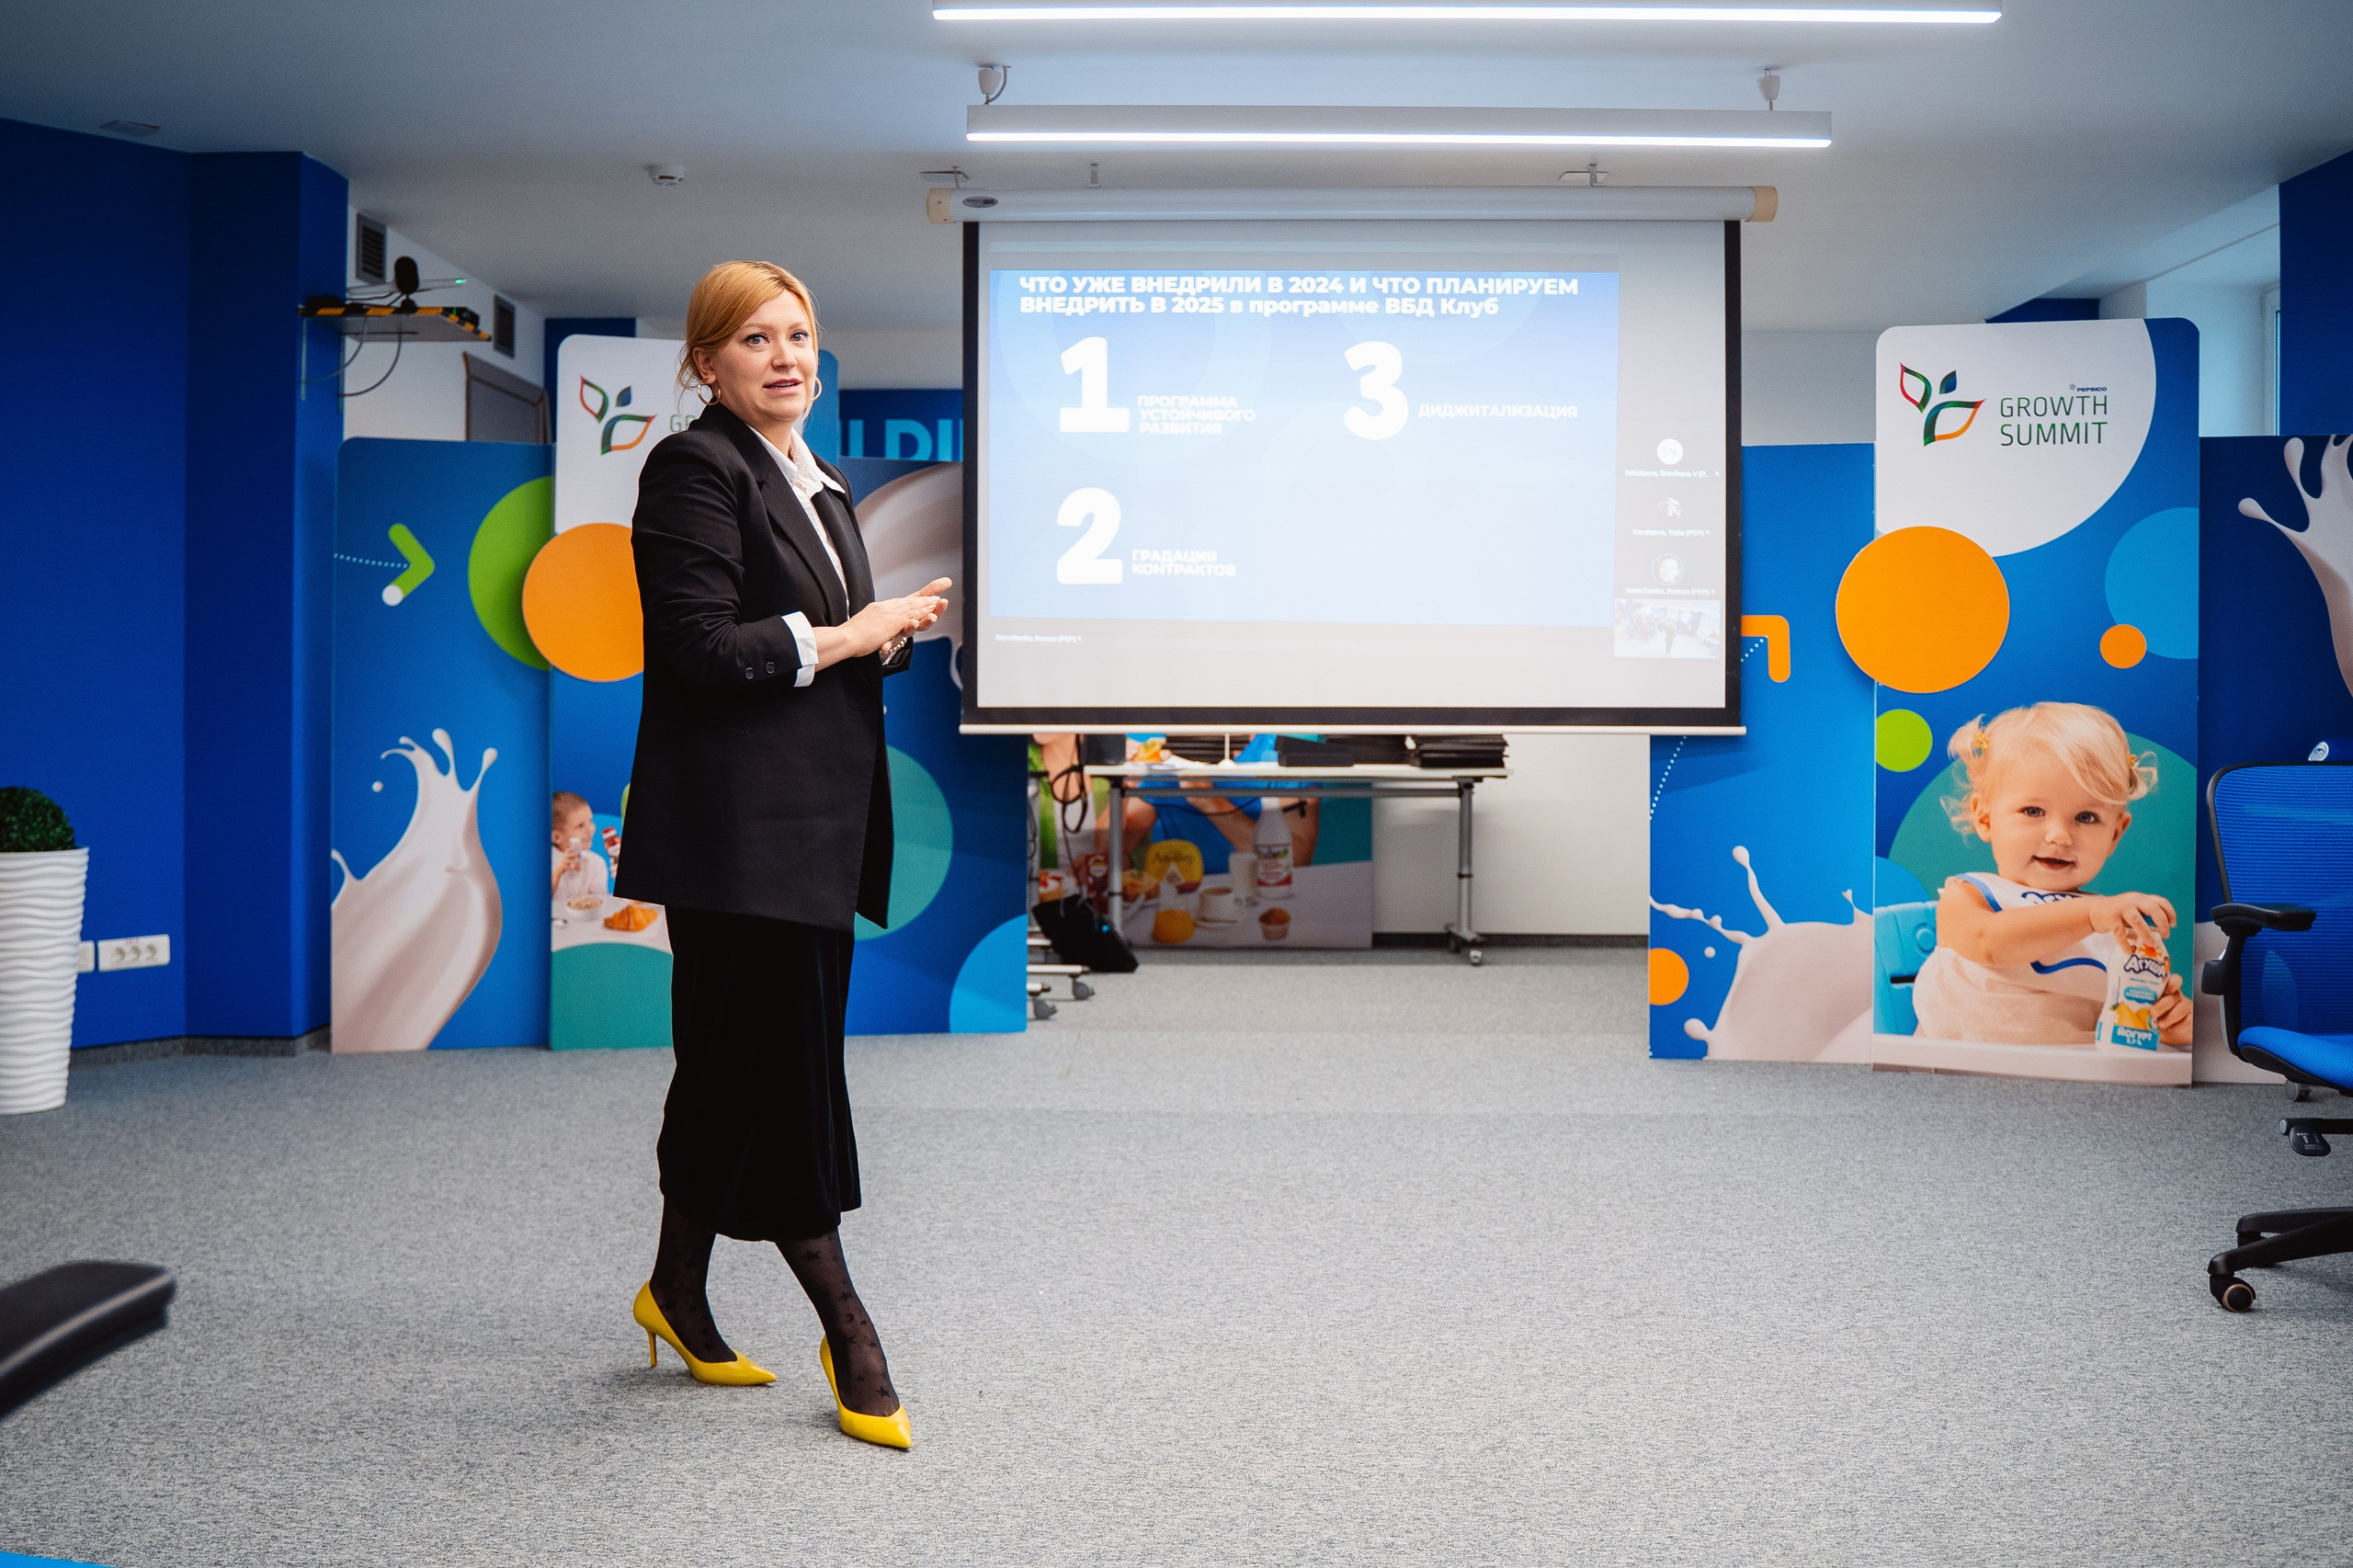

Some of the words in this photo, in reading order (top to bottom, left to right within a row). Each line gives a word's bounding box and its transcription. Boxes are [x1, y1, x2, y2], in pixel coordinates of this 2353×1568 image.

[1019, 277, 1067, 293] ЧТО
[1073, 277, 1126, 293] УЖЕ
[1131, 277, 1261, 296] ВНЕДРИЛИ
[1267, 278, 1284, 293] В
[1289, 277, 1344, 293] 2024
[1349, 278, 1366, 293] И
[1372, 278, 1421, 294] ЧТО
[1427, 278, 1578, 295] ПЛАНИРУЕМ
[1020, 297, 1145, 316] ВНЕДРИТЬ
[1151, 297, 1166, 313] В
[1171, 297, 1224, 313] 2025
[1230, 301, 1244, 313] в
[1249, 300, 1379, 316] программе
[1385, 298, 1435, 316] ВБД
[1440, 298, 1498, 318] Клуб
[1060, 336, 1131, 433] 1
[1344, 340, 1409, 440] 3
[1137, 395, 1238, 408] ПРОГРАММА
[2000, 395, 2108, 418] GROWTH
[1139, 407, 1256, 422] УСТОЙЧИВОГО
[1417, 404, 1578, 420] ДИДЖИТАЛИЗАЦИЯ
[1139, 422, 1222, 435] РАЗВИТИЯ
[2000, 422, 2108, 447] SUMMIT
[1056, 487, 1123, 585] 2
[1131, 549, 1218, 563] ГРАДАЦИЯ
[1131, 562, 1236, 577] КОНТРАКТОВ
